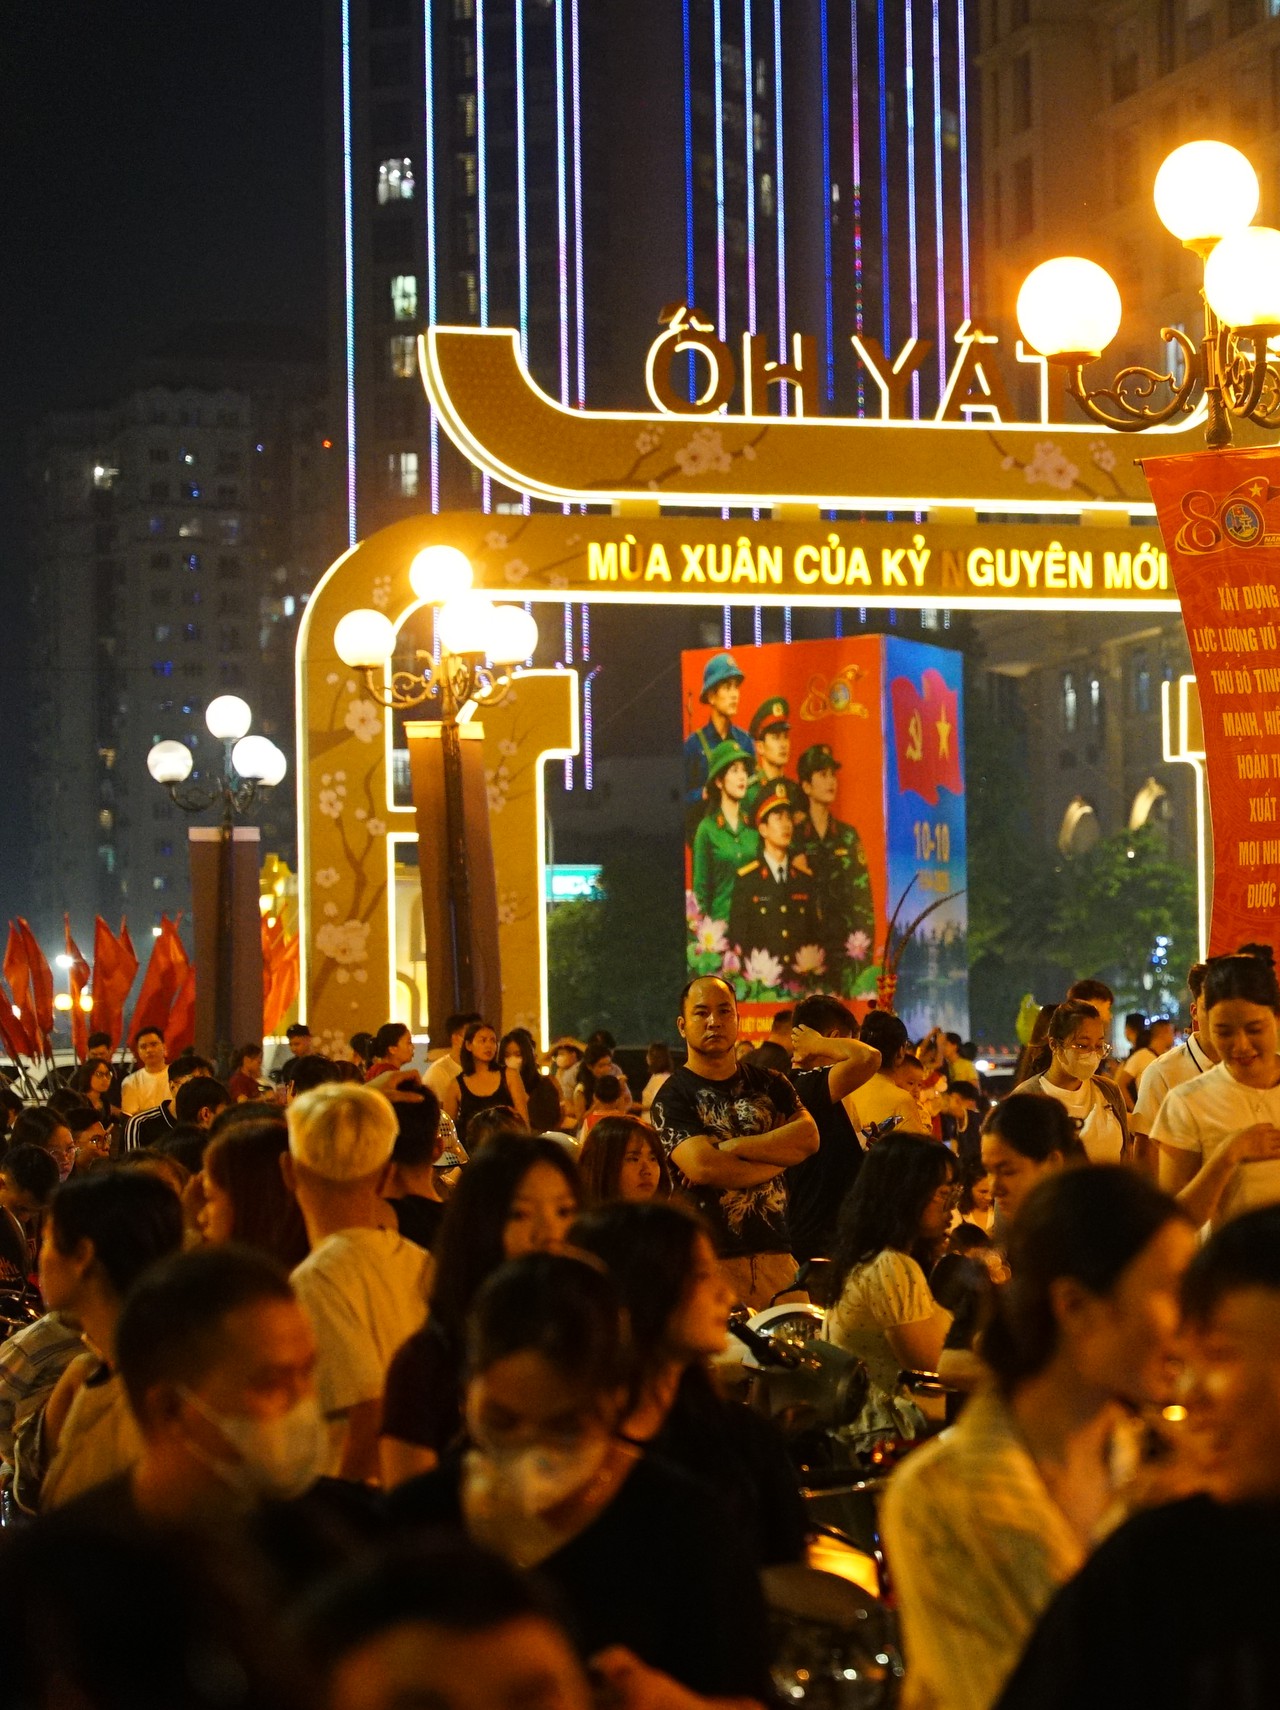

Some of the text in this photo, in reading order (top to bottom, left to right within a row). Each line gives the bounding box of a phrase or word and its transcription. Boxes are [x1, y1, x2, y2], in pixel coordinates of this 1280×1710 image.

[587, 533, 672, 582] MÙA
[680, 535, 783, 584] XUÂN
[793, 532, 872, 585] CỦA
[881, 533, 931, 587] KỶ
[1103, 541, 1168, 590] MỚI
[1217, 582, 1280, 615] XÂY DỰNG
[1193, 626, 1218, 658] LỰC
[1218, 626, 1259, 658] LƯỢNG
[1259, 622, 1277, 650] VŨ
[1211, 662, 1235, 695] THỦ
[1234, 665, 1252, 694] ĐÔ
[1222, 712, 1264, 742] MẠNH,
[1237, 749, 1270, 779] HOÀN
[1249, 787, 1277, 822] XUẤT
[1239, 841, 1260, 871] MỌI
[1247, 880, 1277, 912] ĐƯỢC
